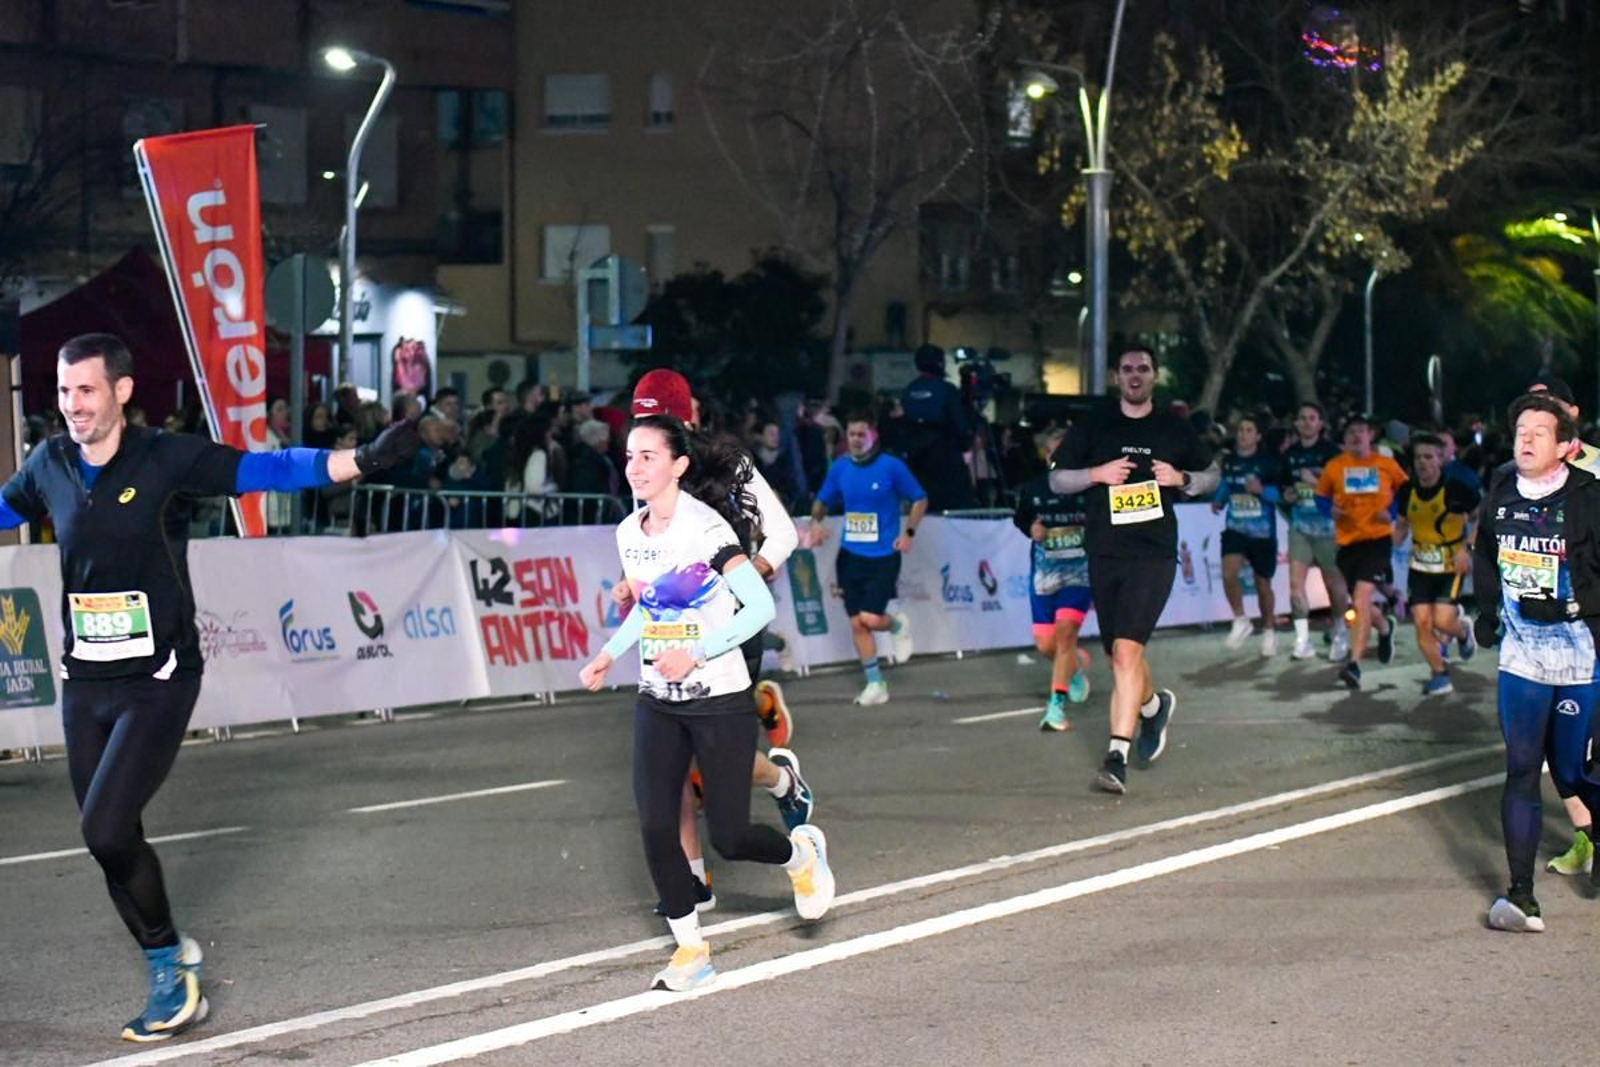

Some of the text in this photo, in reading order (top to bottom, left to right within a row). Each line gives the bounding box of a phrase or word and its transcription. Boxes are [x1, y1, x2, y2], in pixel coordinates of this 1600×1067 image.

[1115, 491, 1155, 509] 3423
[469, 555, 580, 609] 42 SAN
[83, 612, 133, 637] 889
[404, 602, 456, 640] alsa
